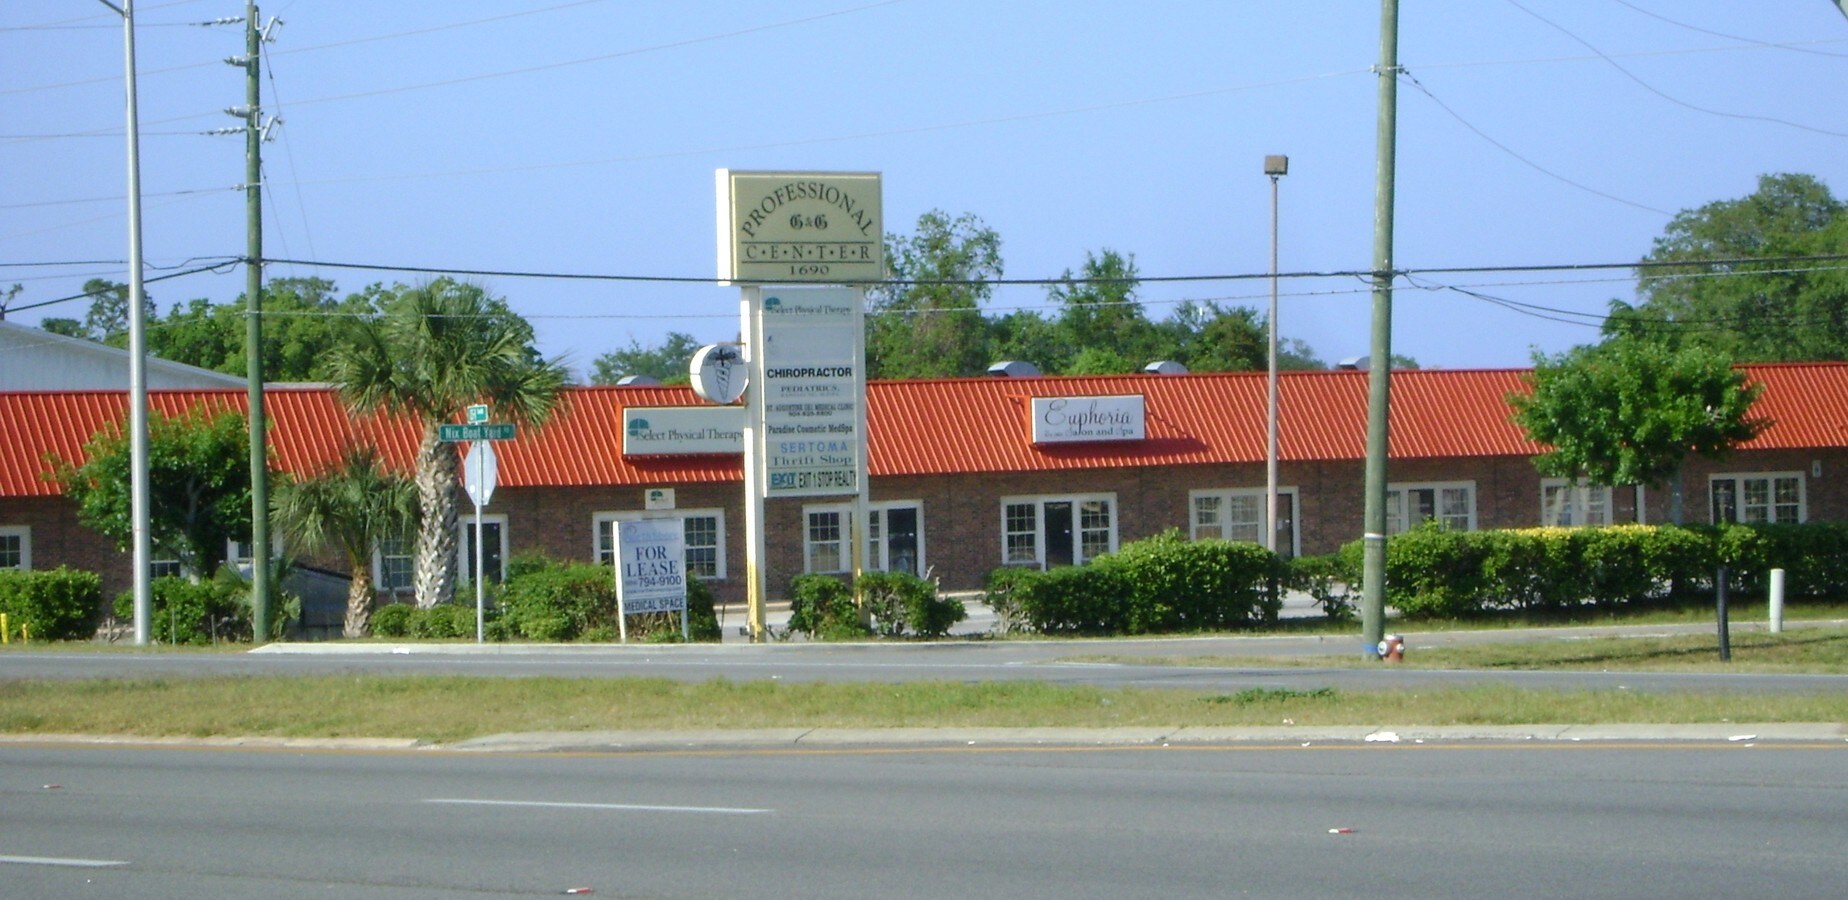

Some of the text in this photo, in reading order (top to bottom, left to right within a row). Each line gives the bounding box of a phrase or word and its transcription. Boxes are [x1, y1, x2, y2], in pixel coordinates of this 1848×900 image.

[741, 181, 873, 239] PROFESSIONAL
[790, 265, 829, 275] 1690
[795, 304, 822, 316] Physical
[823, 304, 852, 316] Therapy
[766, 367, 853, 379] CHIROPRACTOR
[1044, 398, 1132, 433] Euphoria
[445, 427, 460, 439] Nix
[462, 427, 481, 439] Boat
[483, 427, 502, 439] Yard
[637, 428, 665, 441] Select
[668, 428, 704, 443] Physical
[768, 425, 795, 434] Paradise
[796, 424, 826, 433] Cosmetic
[1095, 426, 1114, 436] and
[780, 441, 848, 453] SERTOMA
[772, 454, 852, 467] Thrift Shop
[799, 472, 812, 488] EXIT
[818, 471, 833, 487] STOP
[635, 545, 667, 561] FOR
[626, 560, 679, 577] LEASE
[639, 575, 682, 588] 794-9100
[624, 598, 685, 612] MEDICAL SPACE
